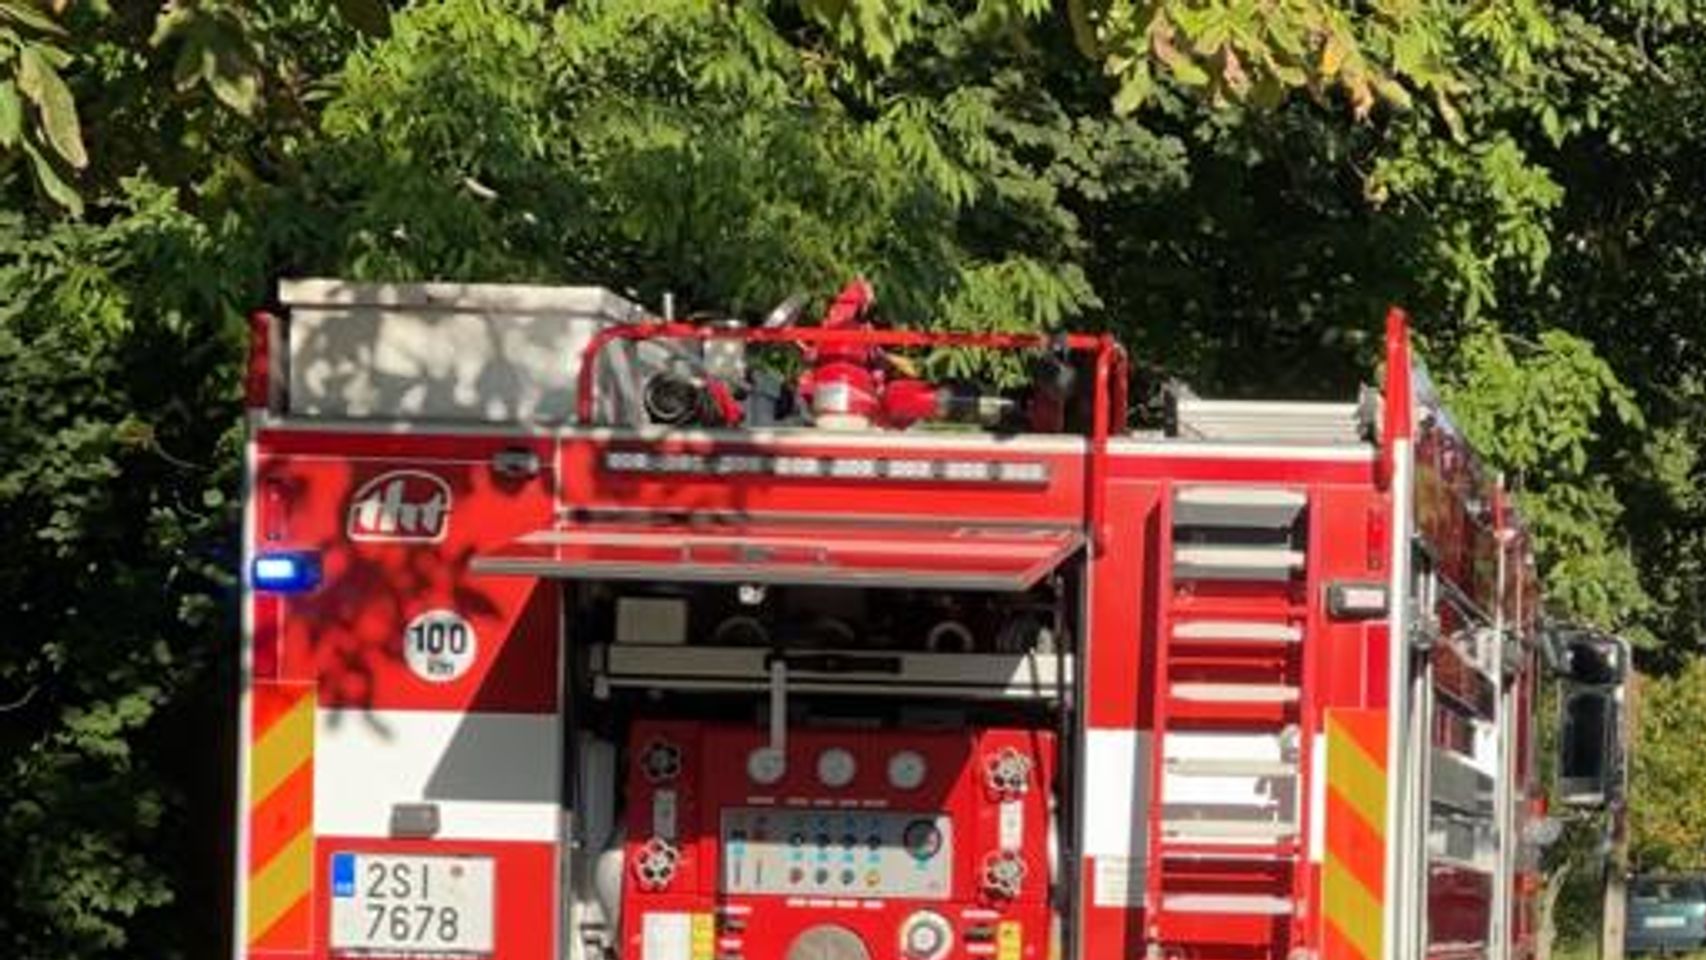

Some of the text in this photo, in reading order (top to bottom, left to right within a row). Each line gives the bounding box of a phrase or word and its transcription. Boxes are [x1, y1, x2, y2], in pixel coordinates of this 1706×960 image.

[410, 622, 467, 654] 100
[367, 862, 429, 900] 2SI
[366, 903, 460, 942] 7678
